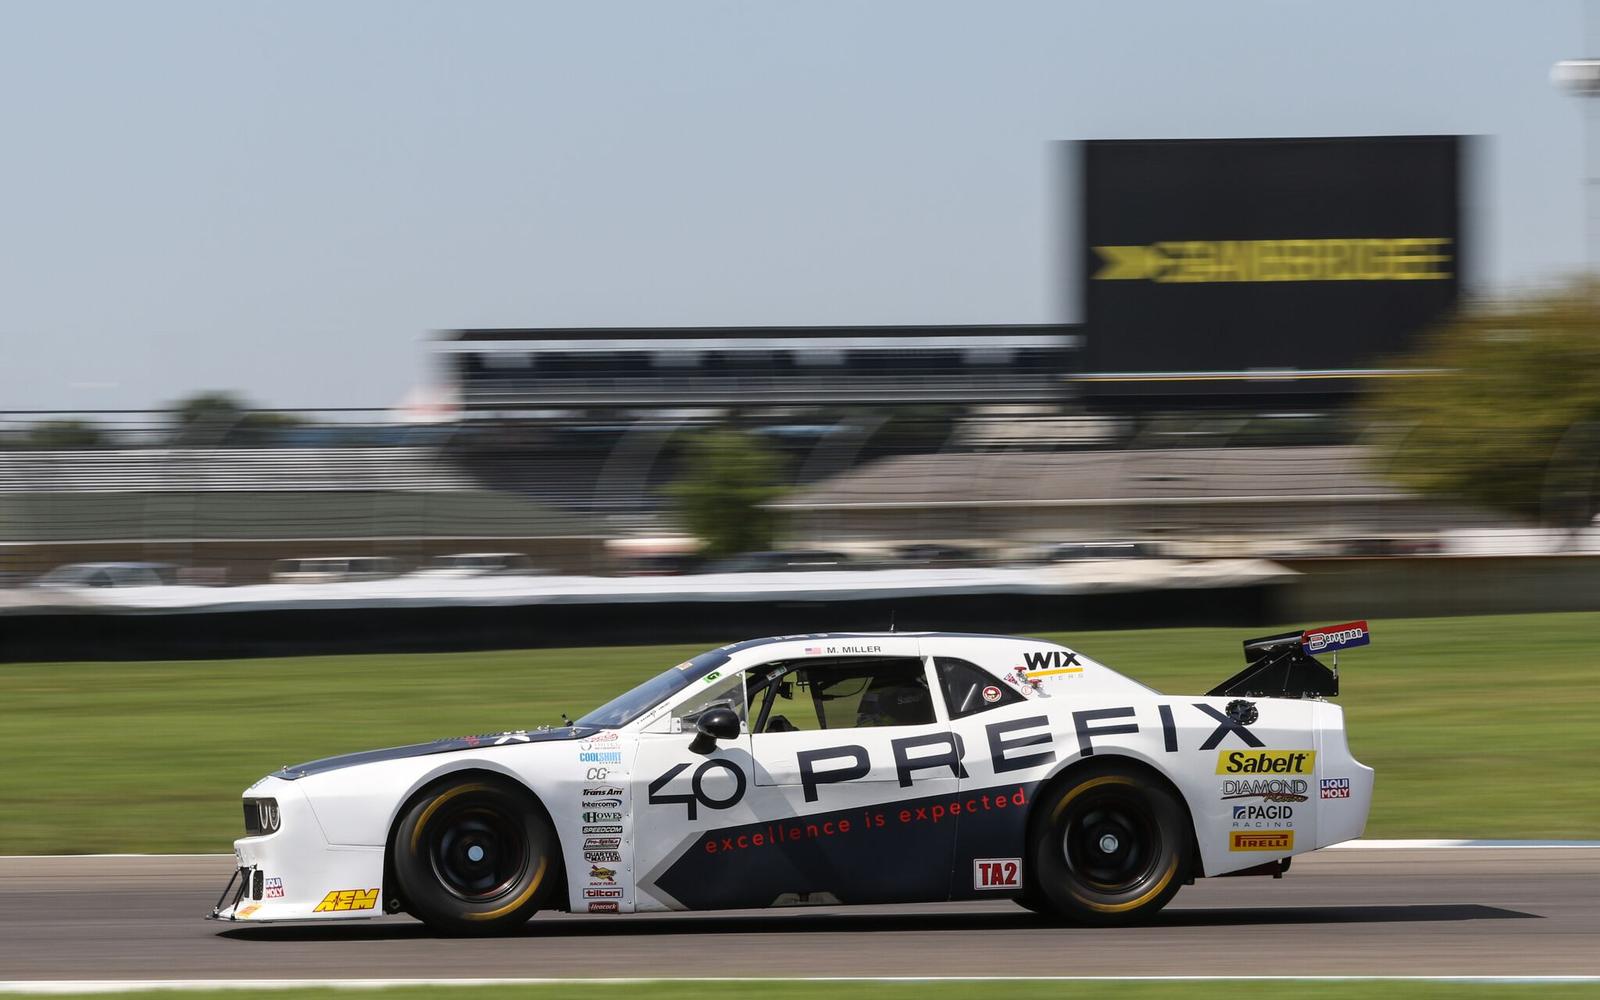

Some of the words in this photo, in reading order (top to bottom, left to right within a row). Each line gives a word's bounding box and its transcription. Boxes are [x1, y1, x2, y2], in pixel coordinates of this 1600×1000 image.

[842, 646, 881, 654] MILLER
[1024, 652, 1081, 671] WIX
[797, 703, 1266, 802] PREFIX
[1226, 752, 1306, 773] Sabelt
[587, 768, 607, 780] CG
[607, 788, 622, 796] Am
[648, 758, 747, 821] 40
[1223, 779, 1308, 795] DIAMOND
[1321, 780, 1348, 789] LIQUI
[1321, 788, 1349, 798] MOLY
[1248, 806, 1293, 819] PAGID
[705, 819, 850, 853] excellence
[865, 811, 885, 829] is
[1235, 834, 1288, 848] PIRELLI
[978, 862, 1017, 886] TA2
[312, 889, 380, 912] AEM
[586, 889, 621, 897] tilton
